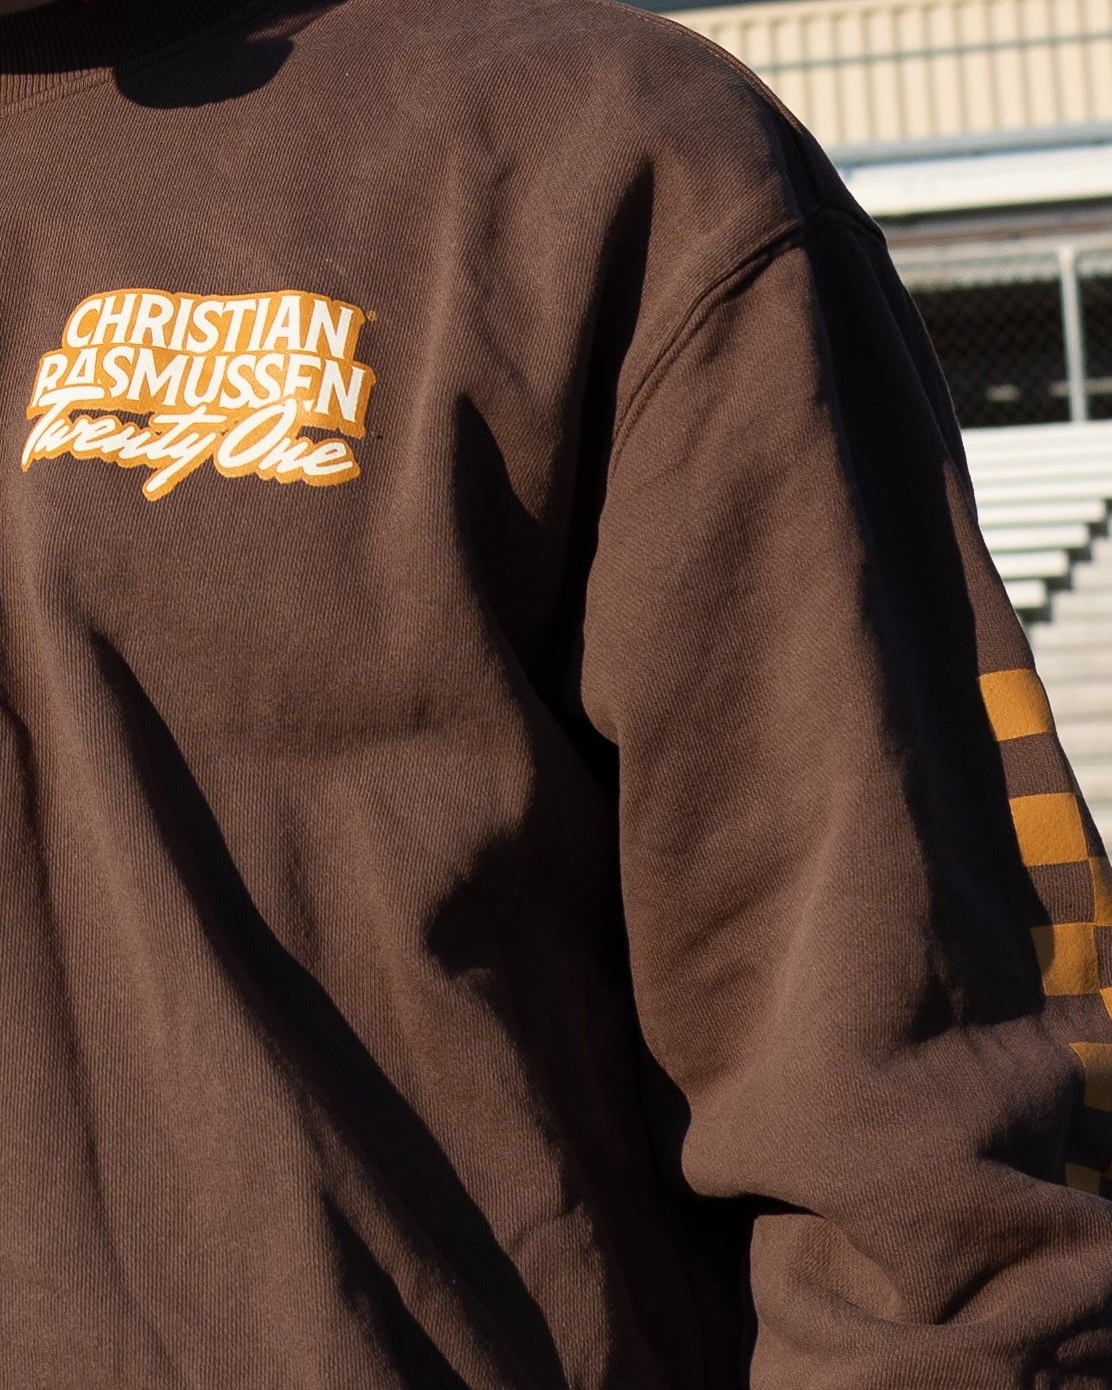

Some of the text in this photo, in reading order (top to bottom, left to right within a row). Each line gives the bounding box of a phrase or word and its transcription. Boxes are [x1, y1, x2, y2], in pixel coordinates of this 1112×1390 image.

[66, 293, 355, 360] CHRISTIAN
[31, 347, 366, 423] RASMUSSEN
[21, 385, 354, 493] Twenty One
